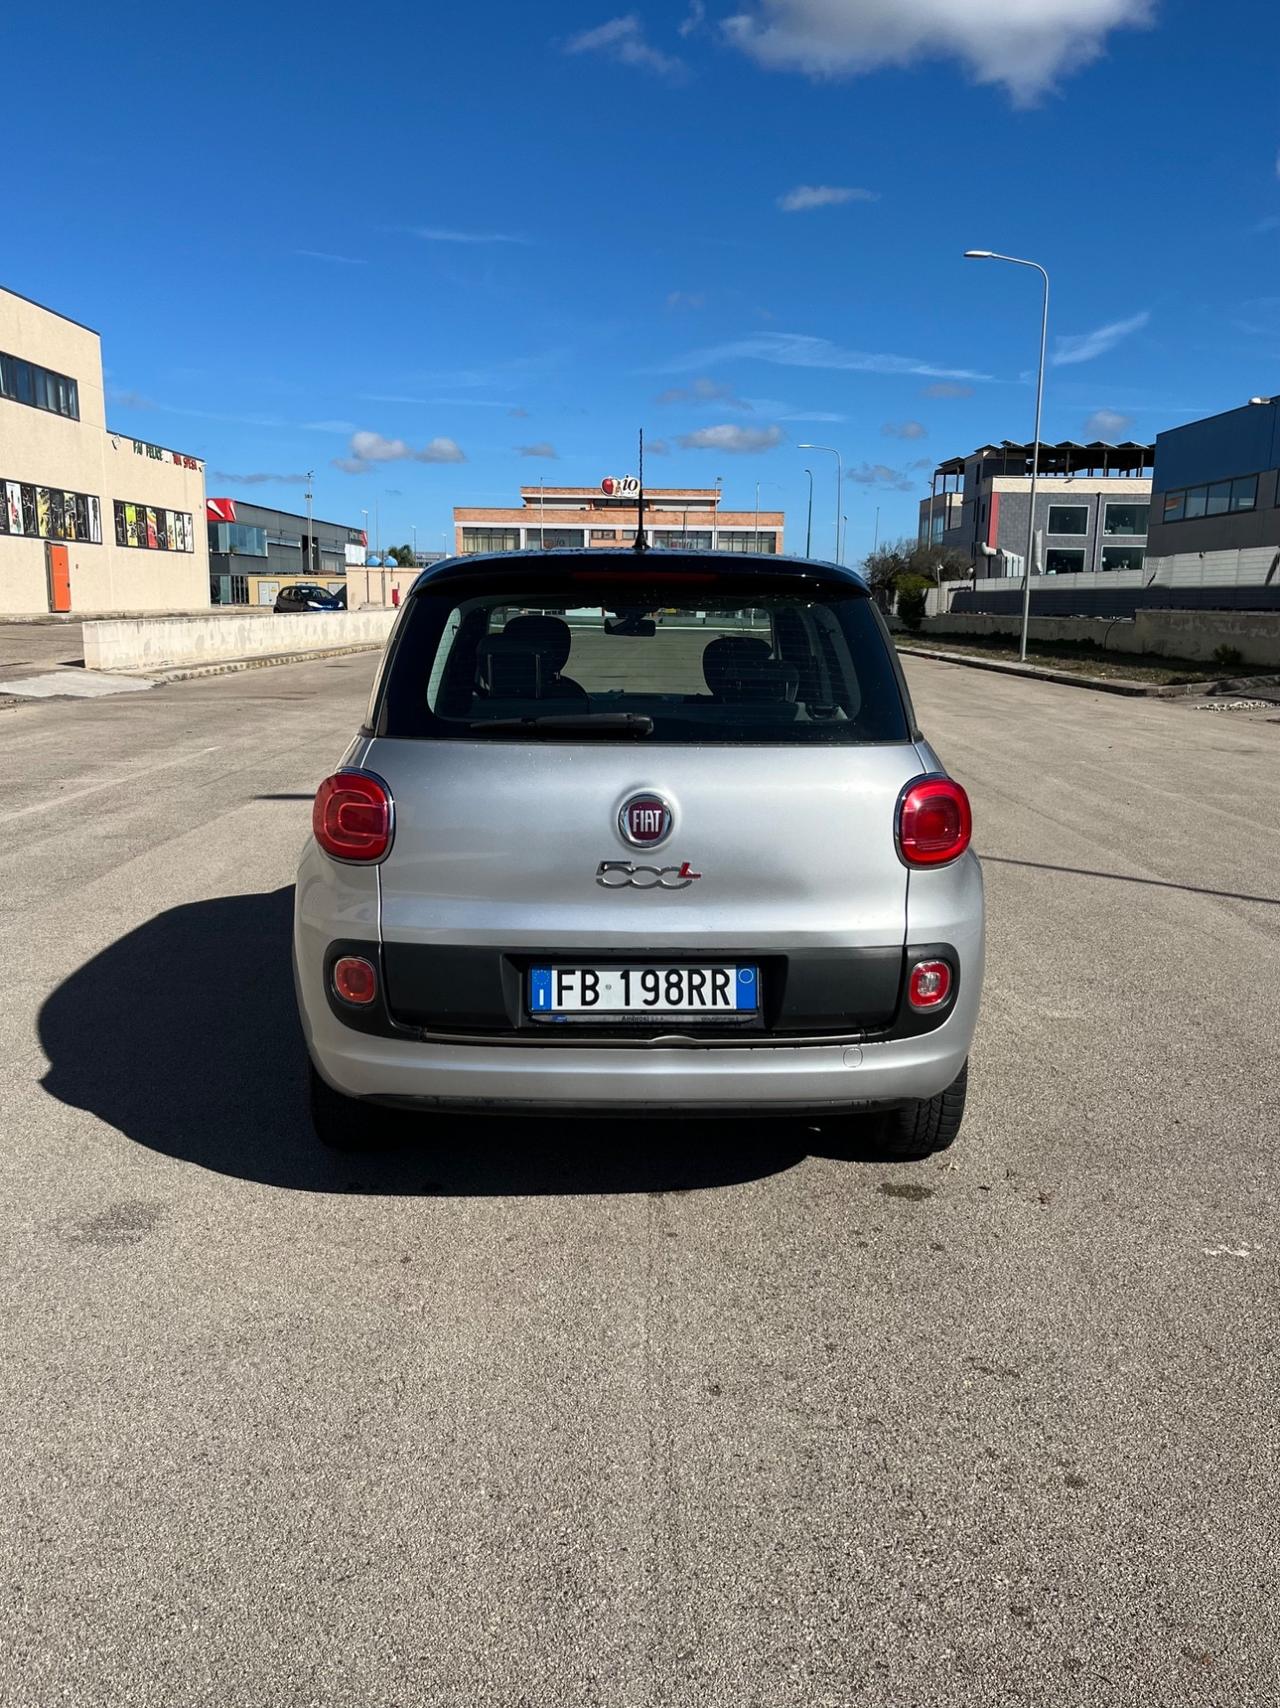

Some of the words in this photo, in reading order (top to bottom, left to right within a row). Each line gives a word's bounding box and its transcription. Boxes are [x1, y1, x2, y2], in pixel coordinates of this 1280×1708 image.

[632, 809, 662, 833] FIAT
[596, 861, 702, 890] 500L
[556, 969, 600, 1007] FB
[620, 968, 731, 1007] 198RR
